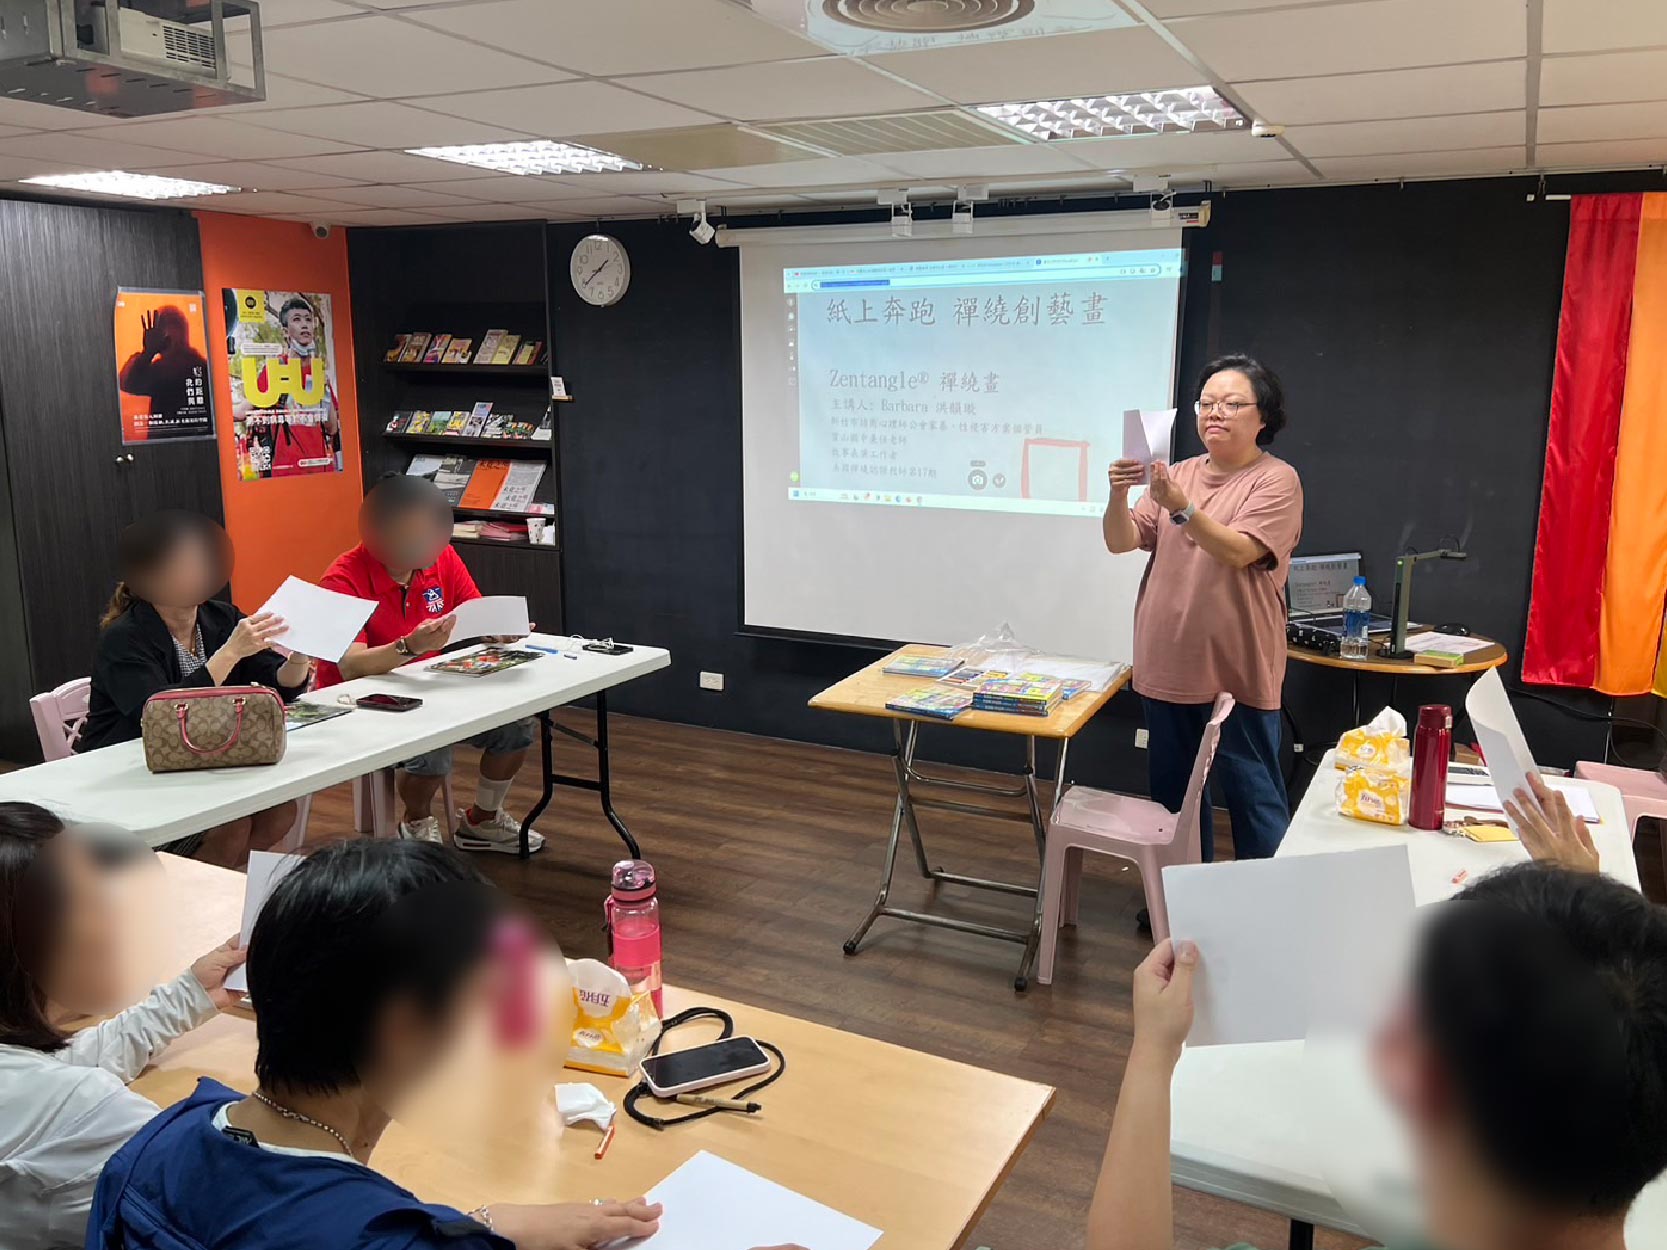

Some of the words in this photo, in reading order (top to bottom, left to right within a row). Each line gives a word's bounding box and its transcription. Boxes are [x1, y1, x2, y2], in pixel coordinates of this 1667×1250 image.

[826, 295, 937, 326] 紙上奔跑
[953, 291, 1108, 328] 禪繞創藝畫
[940, 371, 1000, 394] 禪繞畫
[881, 399, 929, 413] Barbara
